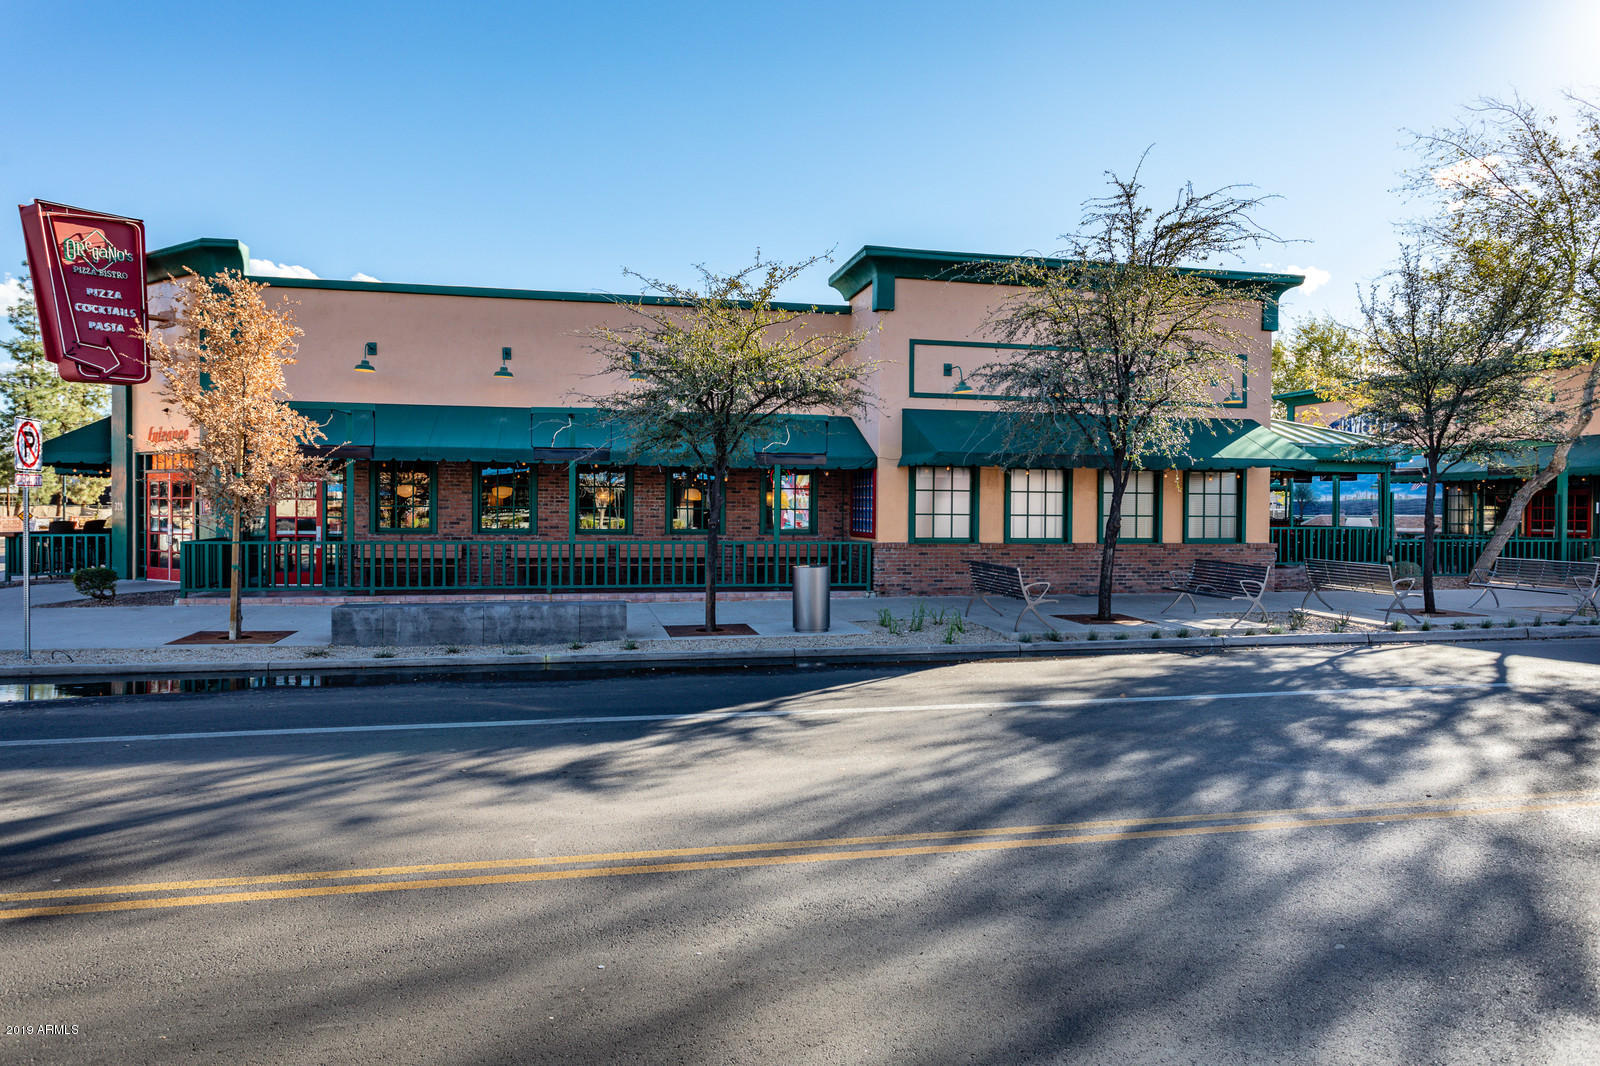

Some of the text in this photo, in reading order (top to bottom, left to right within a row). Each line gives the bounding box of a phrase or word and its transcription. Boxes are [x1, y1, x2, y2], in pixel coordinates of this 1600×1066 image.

[72, 265, 129, 280] PIZZA BISTRO
[86, 287, 122, 299] PIZZA
[74, 302, 137, 318] COCKTAILS
[88, 321, 125, 333] PASTA
